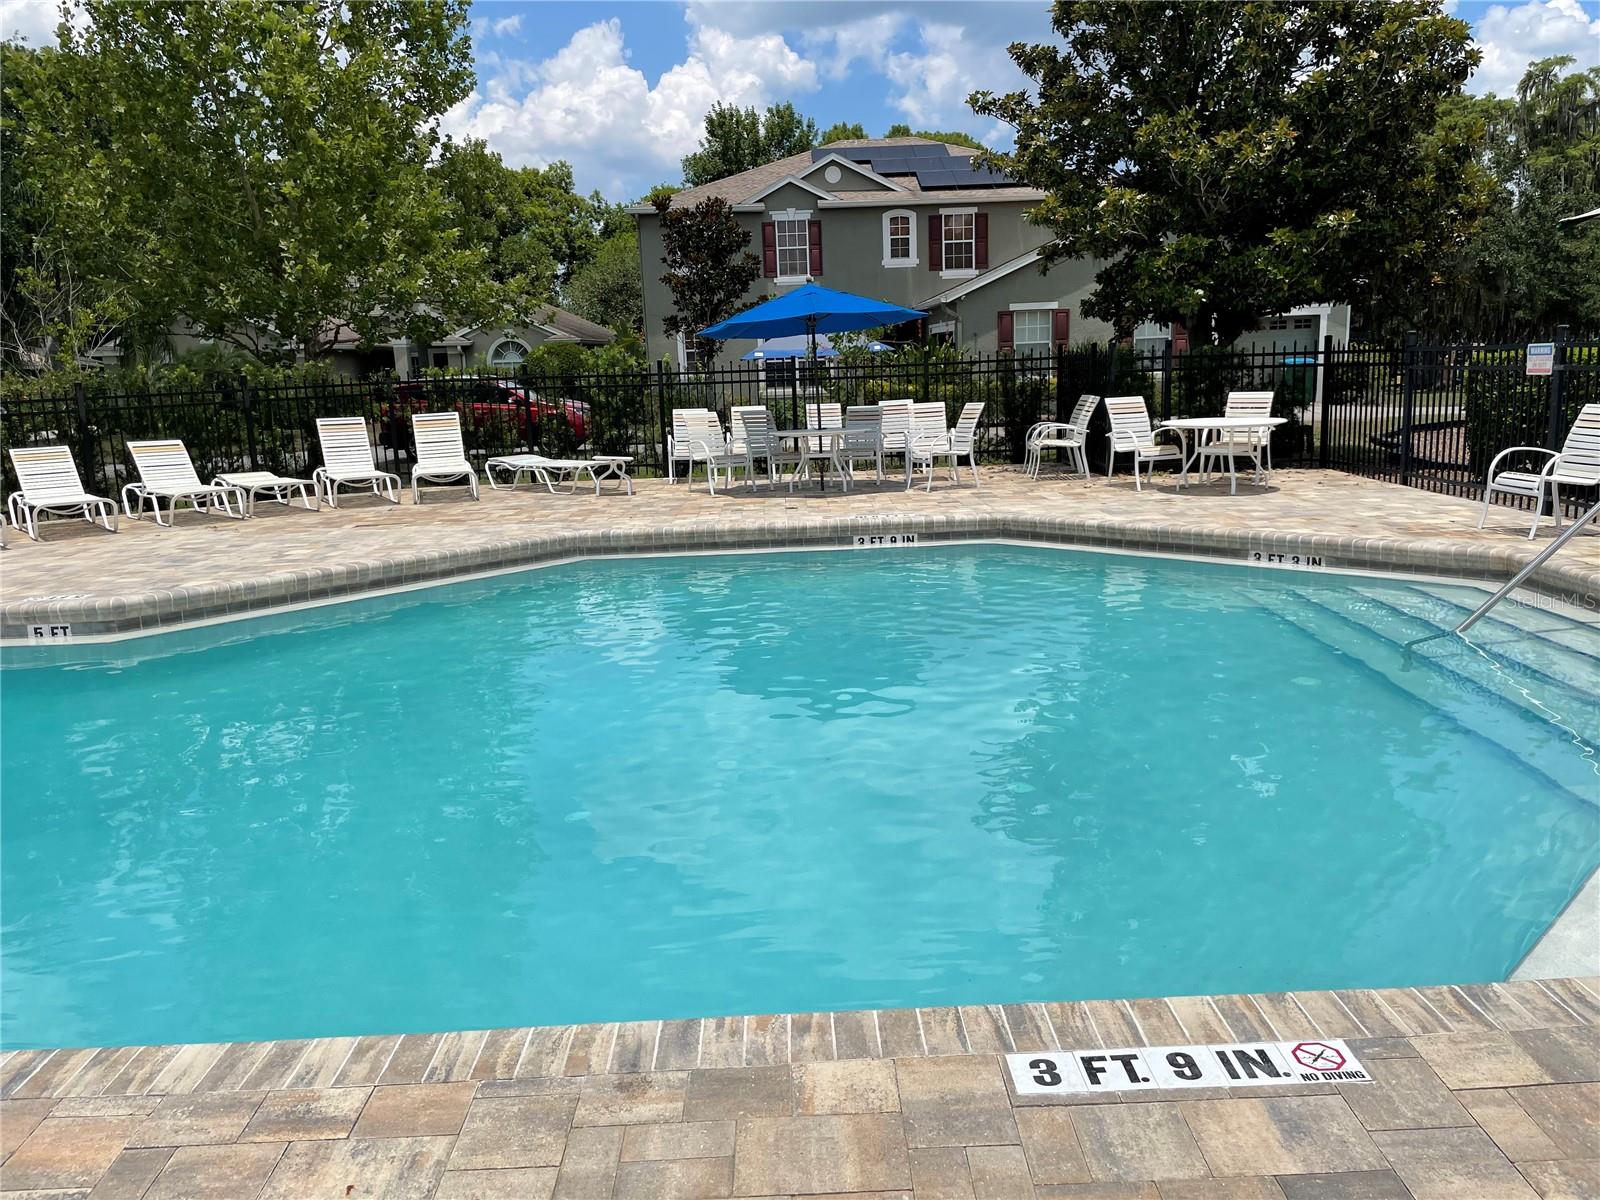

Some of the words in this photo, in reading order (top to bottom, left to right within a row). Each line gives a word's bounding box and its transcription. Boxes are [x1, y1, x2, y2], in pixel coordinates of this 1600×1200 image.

[870, 536, 884, 544] FT
[902, 535, 914, 543] IN
[1268, 553, 1284, 563] FT
[1306, 556, 1321, 566] IN
[34, 626, 43, 637] 5
[50, 626, 69, 637] FT
[1029, 1058, 1062, 1087] 3
[1079, 1054, 1150, 1086] FT.
[1165, 1052, 1202, 1081] 9
[1215, 1048, 1292, 1080] IN.
[1300, 1073, 1320, 1082] NO
[1321, 1070, 1367, 1081] DIVING
